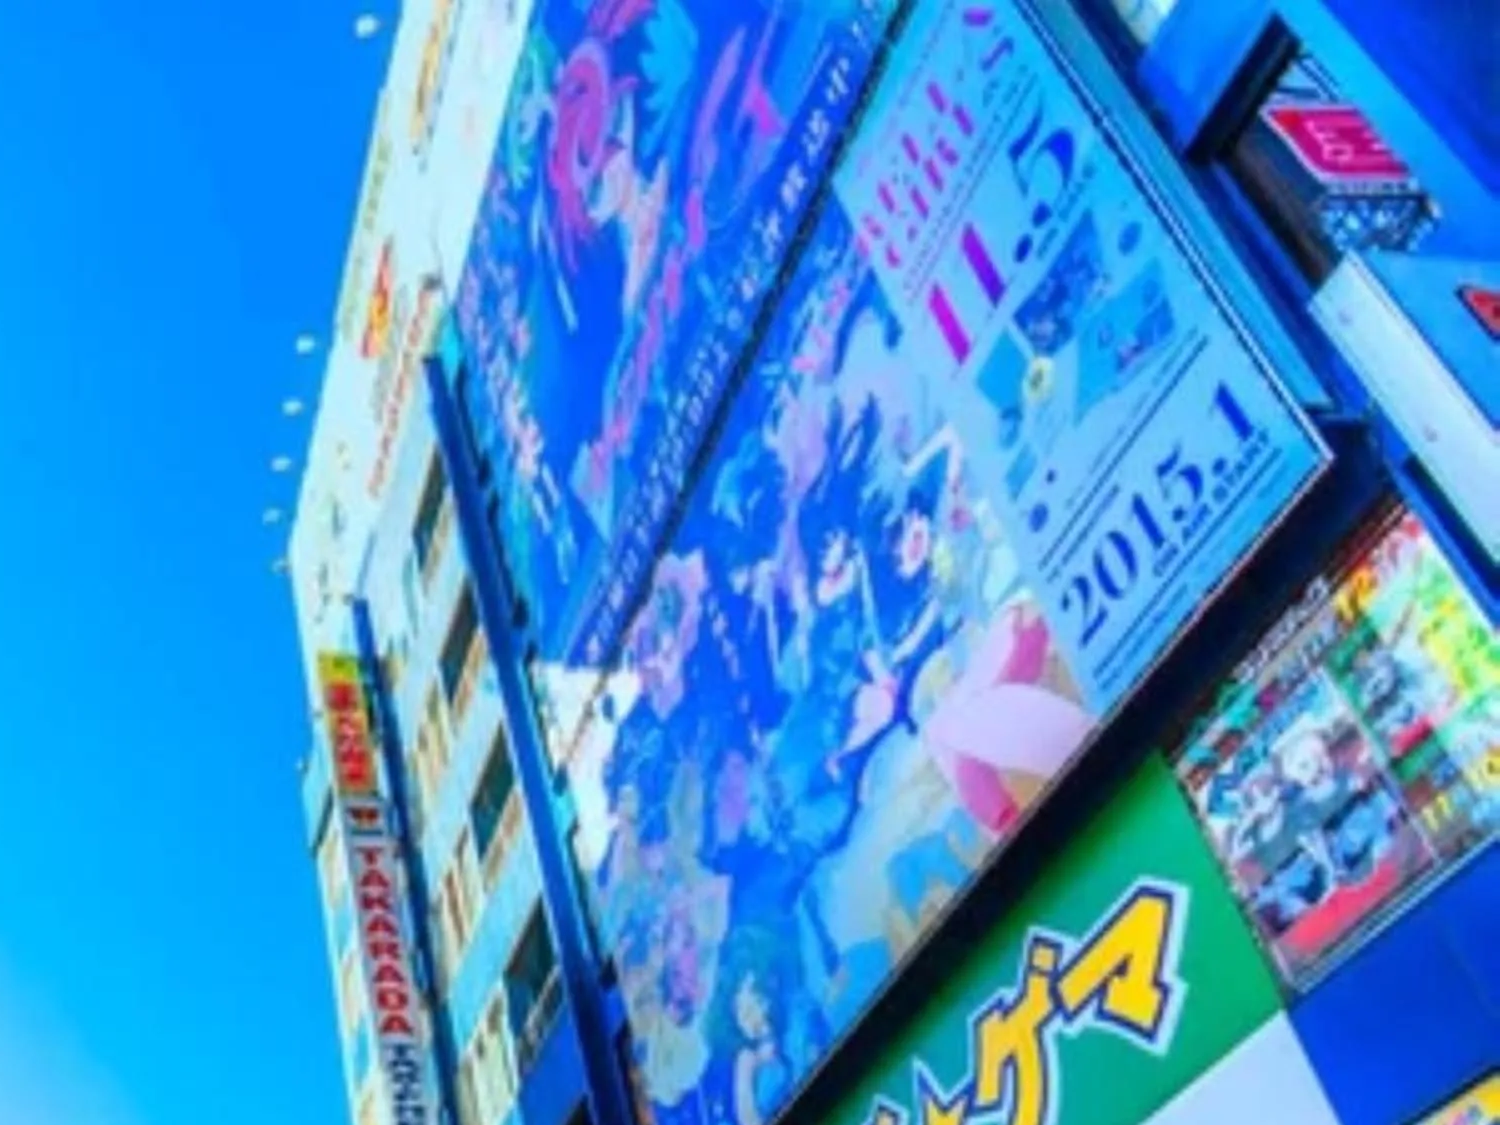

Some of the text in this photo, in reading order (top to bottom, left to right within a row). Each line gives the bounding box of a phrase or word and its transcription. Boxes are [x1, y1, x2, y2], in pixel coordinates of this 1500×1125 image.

[1060, 382, 1254, 646] 2015.1
[1187, 500, 1224, 546] AIR
[1217, 428, 1271, 500] START
[357, 846, 414, 1036] TAKARADA
